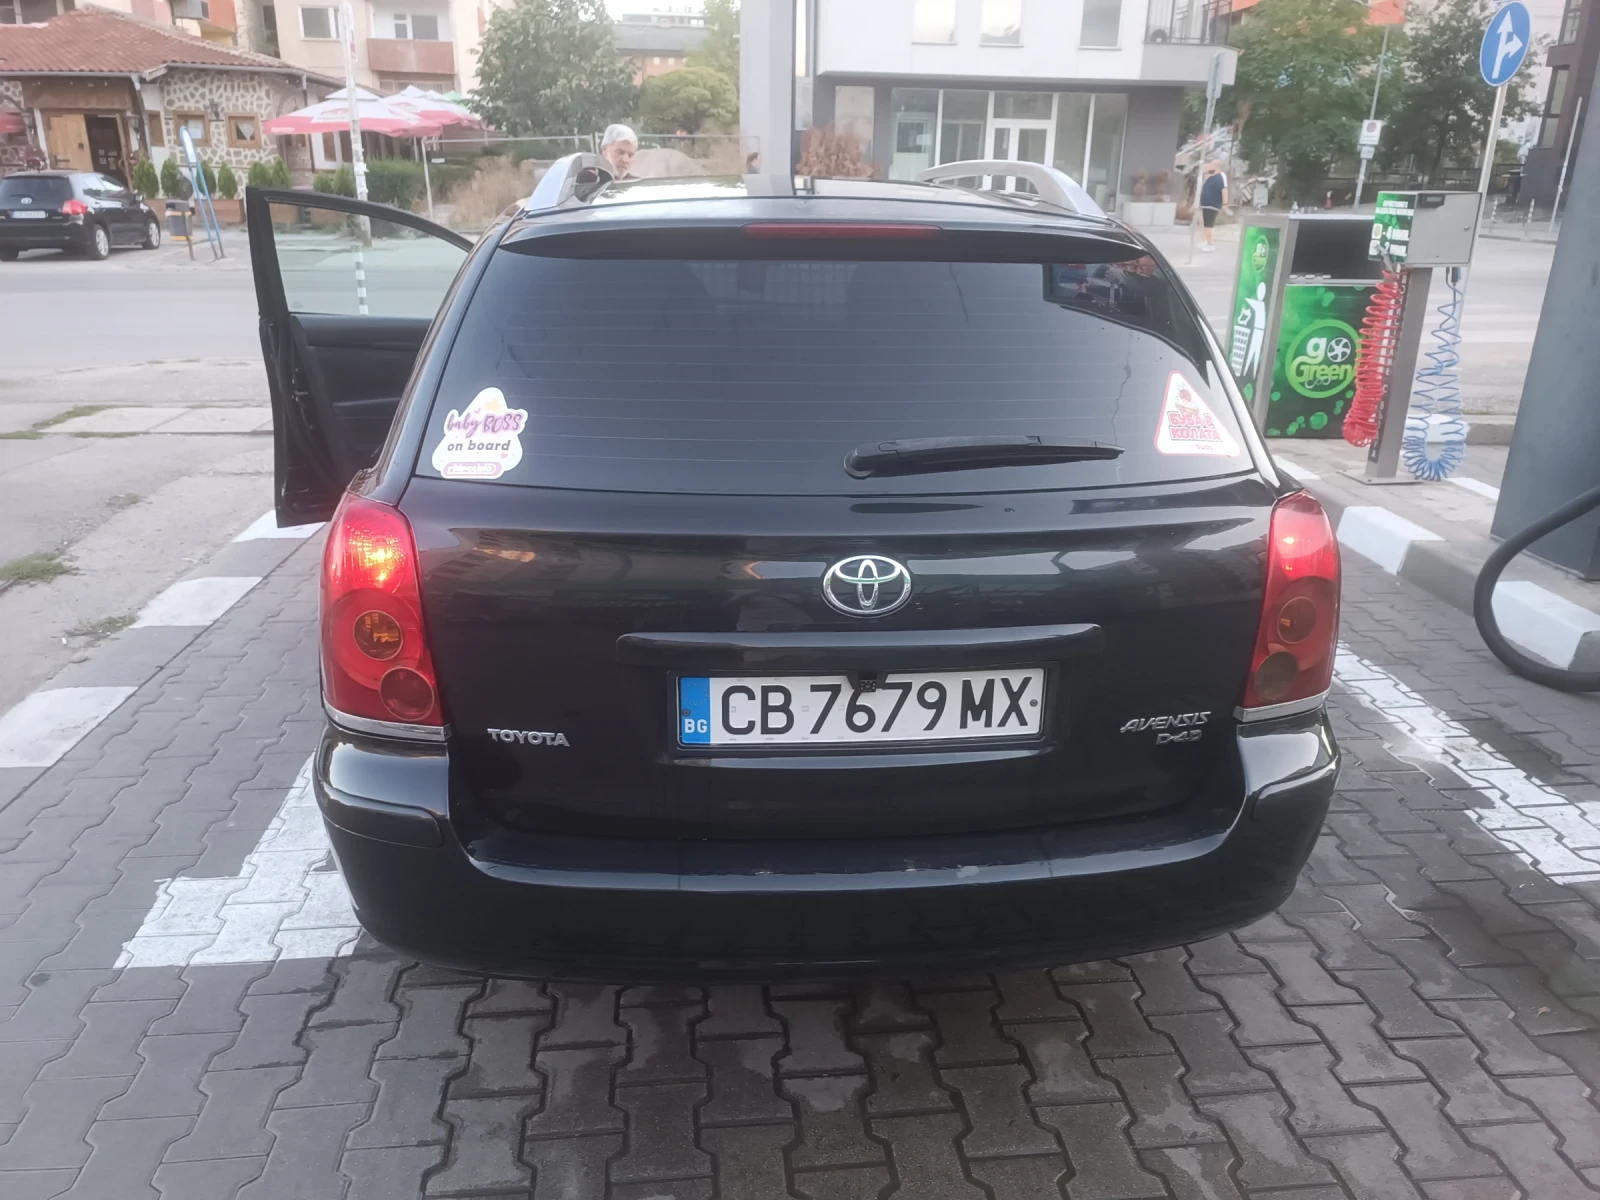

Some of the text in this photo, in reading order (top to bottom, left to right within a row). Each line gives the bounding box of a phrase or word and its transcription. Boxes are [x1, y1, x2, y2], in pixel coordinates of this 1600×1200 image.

[1291, 355, 1354, 382] Green
[447, 412, 523, 439] baby BOSS
[1168, 412, 1203, 427] БУБА
[1170, 427, 1221, 441] КОЛАТА
[447, 440, 511, 451] on board
[721, 676, 1033, 735] CB 7679 MX
[683, 718, 708, 734] BG
[1120, 711, 1212, 733] AVENSIS
[487, 728, 570, 747] TOYOTA
